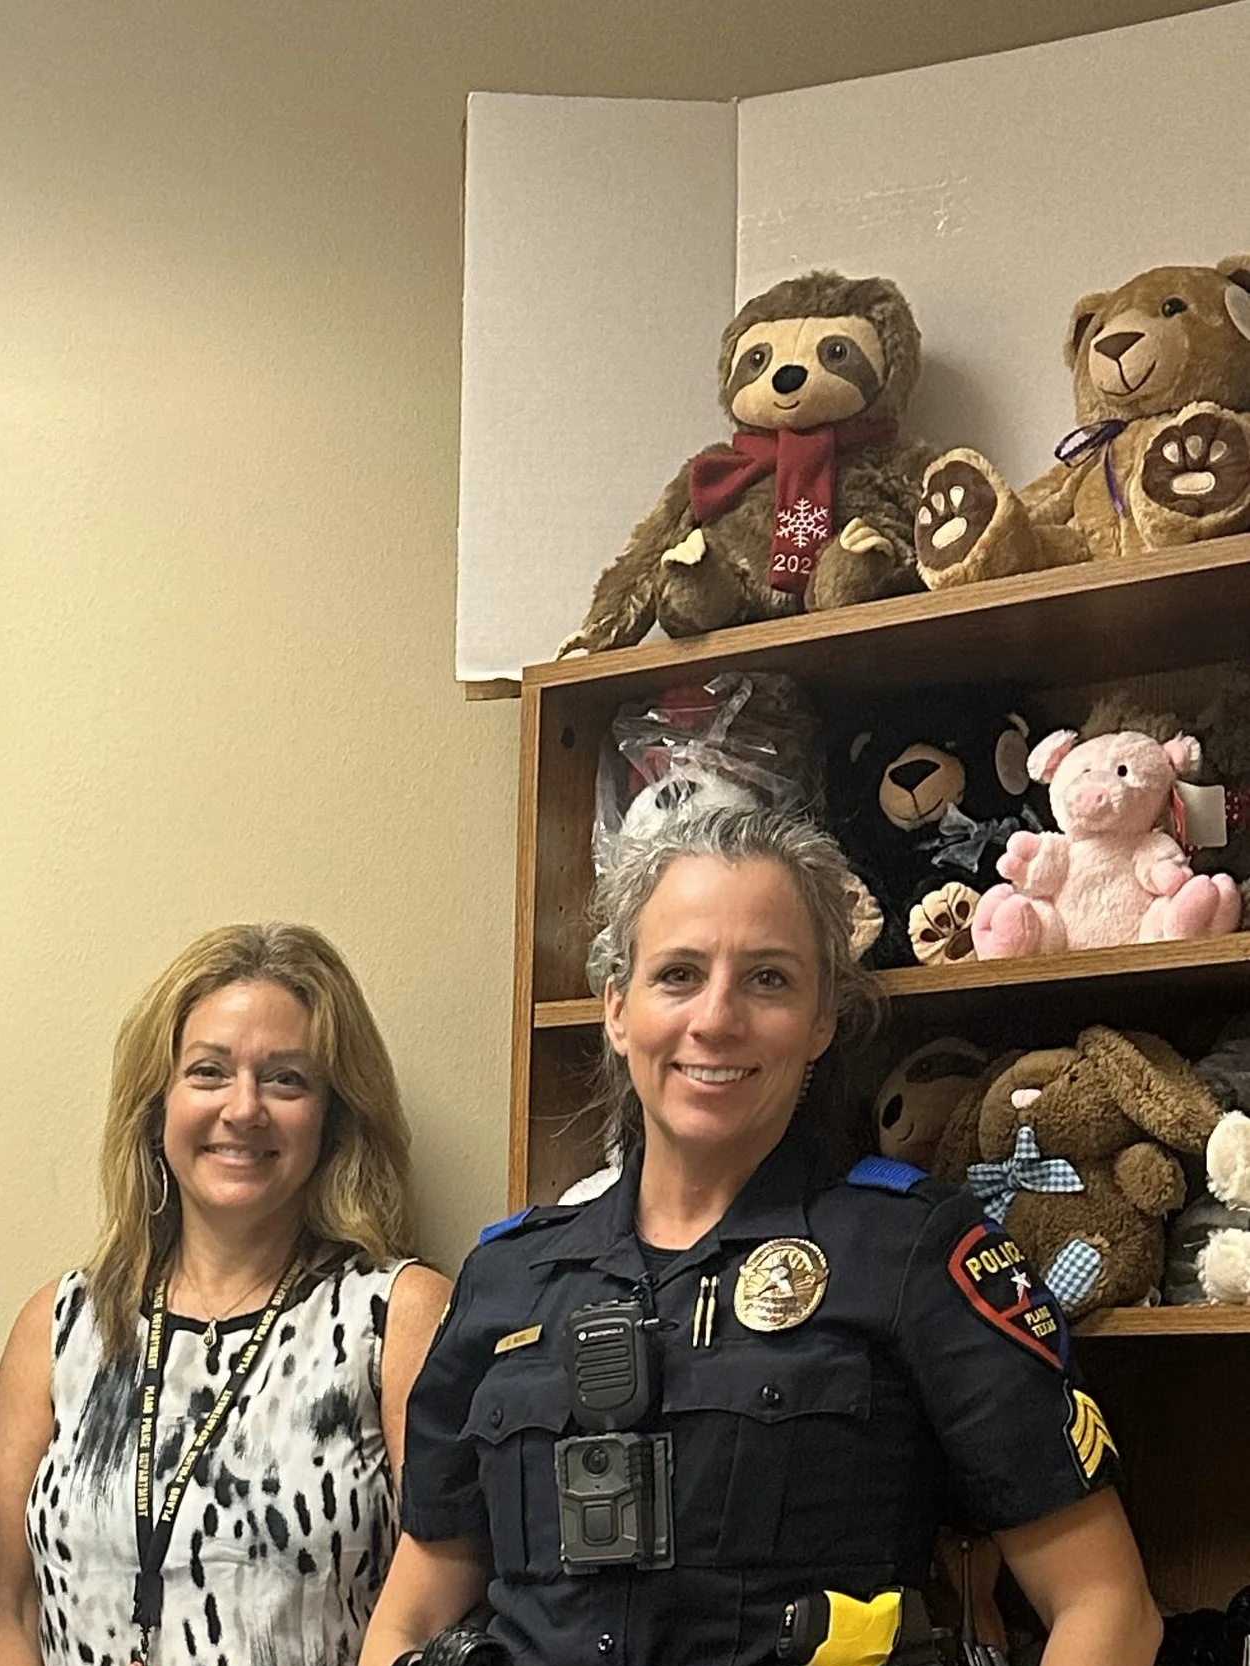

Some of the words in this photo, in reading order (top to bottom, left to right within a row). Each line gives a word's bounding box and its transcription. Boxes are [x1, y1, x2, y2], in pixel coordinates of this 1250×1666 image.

[772, 553, 812, 575] 202
[235, 1344, 259, 1374] PLANO
[253, 1309, 277, 1341] POLICE
[143, 1385, 156, 1414] PLANO
[140, 1418, 152, 1448] POLICE
[161, 1487, 181, 1522] PLANO
[175, 1451, 198, 1483] POLICE
[195, 1389, 233, 1447] DEPARTMENT
[137, 1452, 150, 1517] DEPARTMENT
